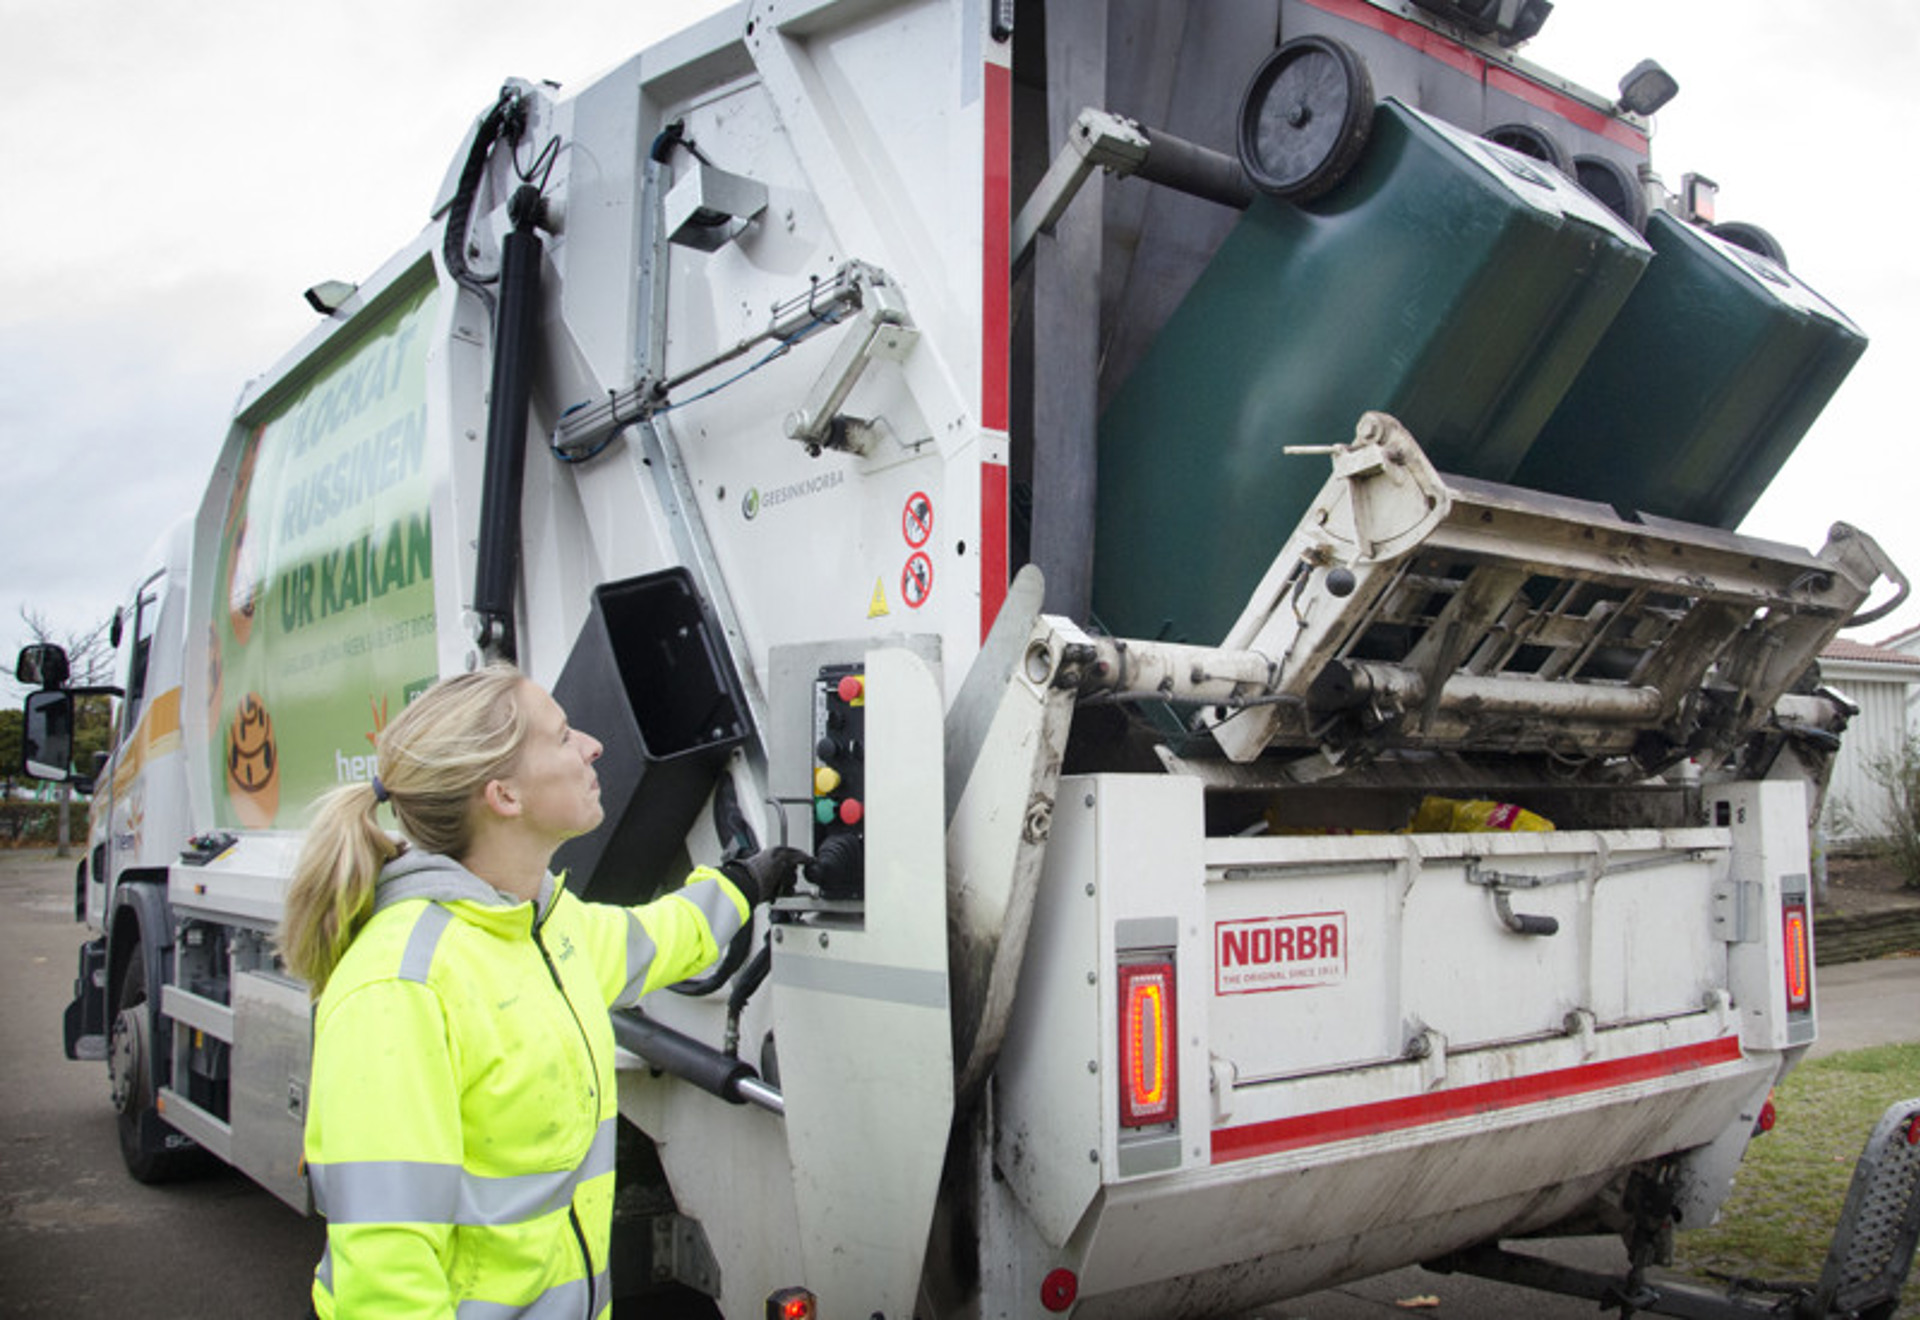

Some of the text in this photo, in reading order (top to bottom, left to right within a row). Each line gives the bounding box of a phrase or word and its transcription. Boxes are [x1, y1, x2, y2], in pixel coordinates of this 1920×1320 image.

[280, 403, 428, 543] RUSSINEN
[762, 470, 844, 507] GEESINKNORBA
[281, 506, 431, 632] UR KAKAN
[1221, 923, 1339, 967] NORBA
[1222, 974, 1241, 984] THE
[1243, 971, 1286, 983] ORIGINAL
[1289, 967, 1314, 978] SINCE
